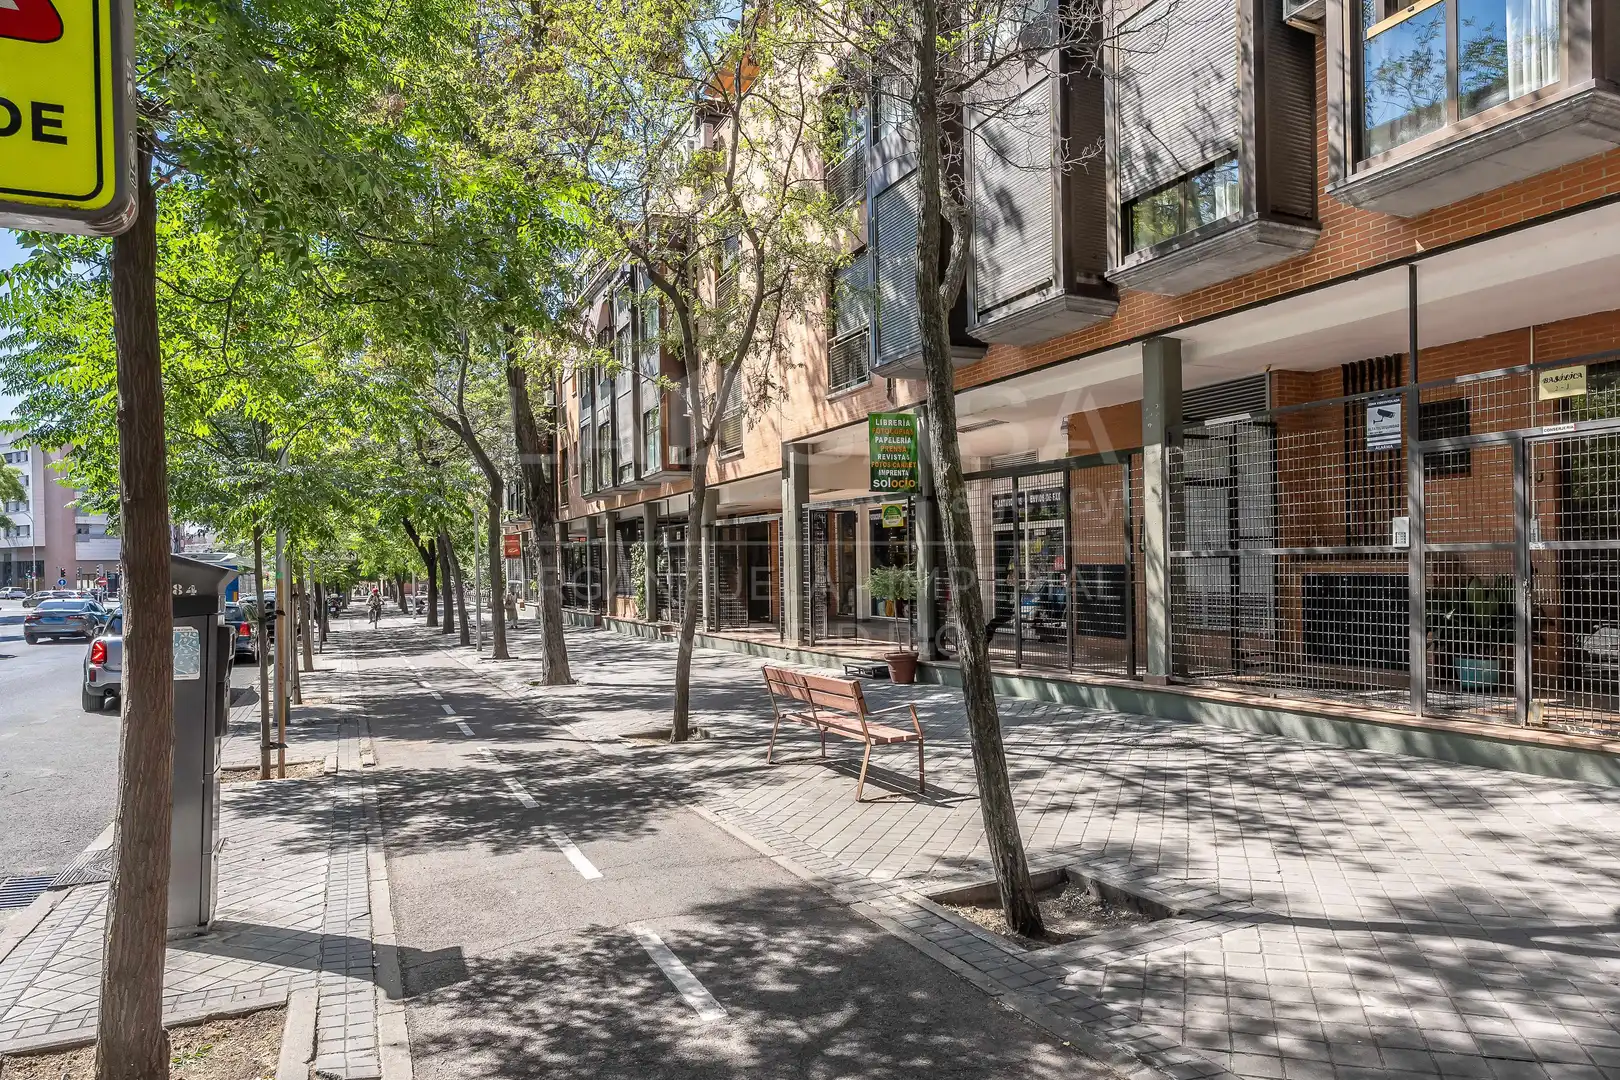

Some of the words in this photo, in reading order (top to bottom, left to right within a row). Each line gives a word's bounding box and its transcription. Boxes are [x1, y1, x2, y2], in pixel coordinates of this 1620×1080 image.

[875, 418, 911, 427] LIBRERÍA
[872, 427, 914, 435] FOTOCOPIAS
[875, 436, 913, 444] PAPELERÍA
[880, 445, 907, 453] PRENSA
[877, 453, 910, 461] REVISTAS
[878, 469, 910, 477] IMPRENTA
[873, 477, 916, 488] solocio
